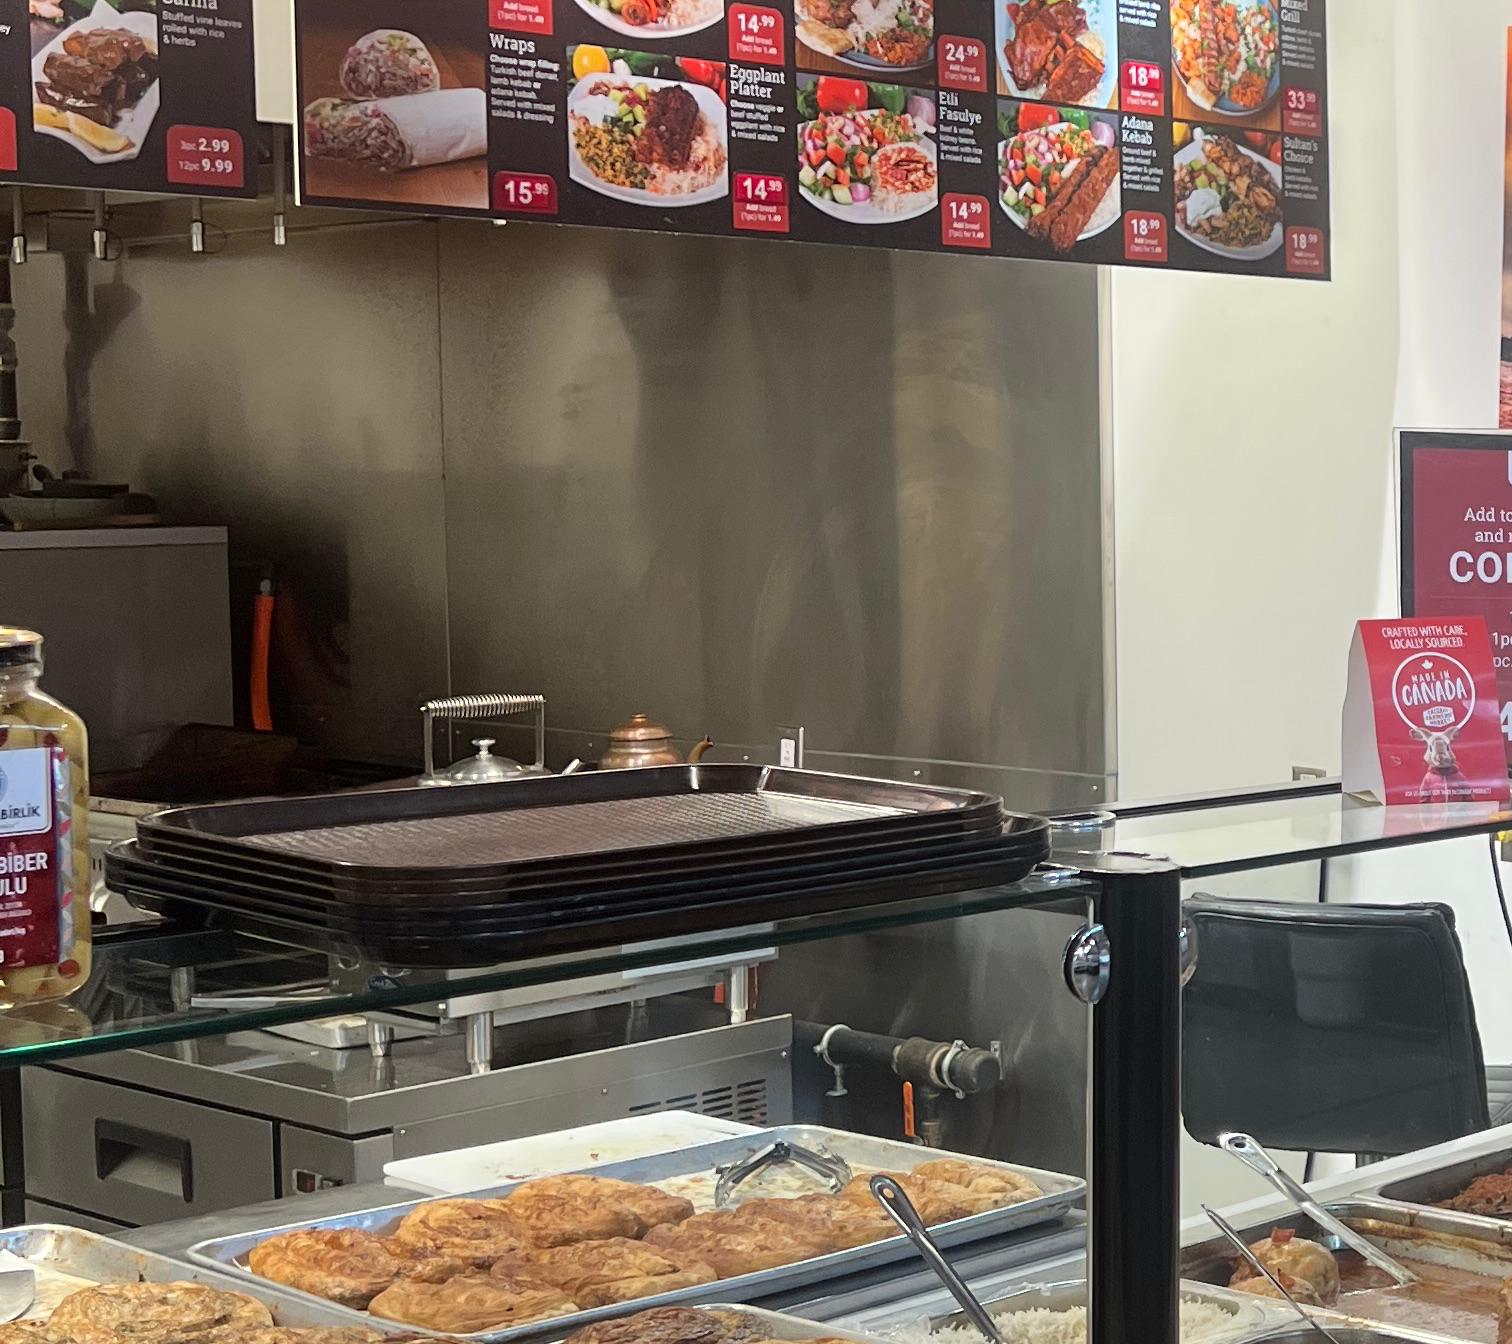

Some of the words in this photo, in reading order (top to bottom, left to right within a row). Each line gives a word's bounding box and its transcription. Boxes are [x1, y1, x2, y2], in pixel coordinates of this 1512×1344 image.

[162, 10, 194, 25] Stuffed
[195, 15, 214, 26] vine
[738, 14, 775, 32] 14.99
[1280, 10, 1300, 23] Grill
[162, 23, 187, 34] rolled
[188, 25, 208, 37] with
[163, 34, 170, 44] &
[171, 36, 196, 47] herbs
[490, 33, 536, 54] Wraps
[945, 43, 978, 63] 24.99
[729, 64, 786, 85] Eggplant
[730, 80, 772, 98] Platter
[940, 107, 982, 126] Fasulye
[1122, 116, 1154, 132] Adana
[198, 138, 230, 153] 2.99
[1122, 130, 1153, 145] Kebab
[1284, 136, 1318, 152] Sultan's
[1284, 150, 1314, 164] Choice
[202, 159, 233, 173] 9.99
[504, 180, 548, 204] 15.99
[743, 177, 782, 200] 14.99
[950, 202, 982, 220] 14.99
[1131, 218, 1160, 236] 18.99
[1464, 508, 1496, 522] Add
[1475, 529, 1504, 543] and
[1382, 626, 1418, 638] CRAFTED
[1419, 626, 1442, 636] WITH
[1390, 638, 1424, 650] LOCALLY
[1425, 636, 1464, 648] SOURCED
[1412, 672, 1437, 684] MADE
[1440, 670, 1450, 680] IN
[1402, 676, 1468, 706] CANADA
[0, 852, 48, 874] BİBER
